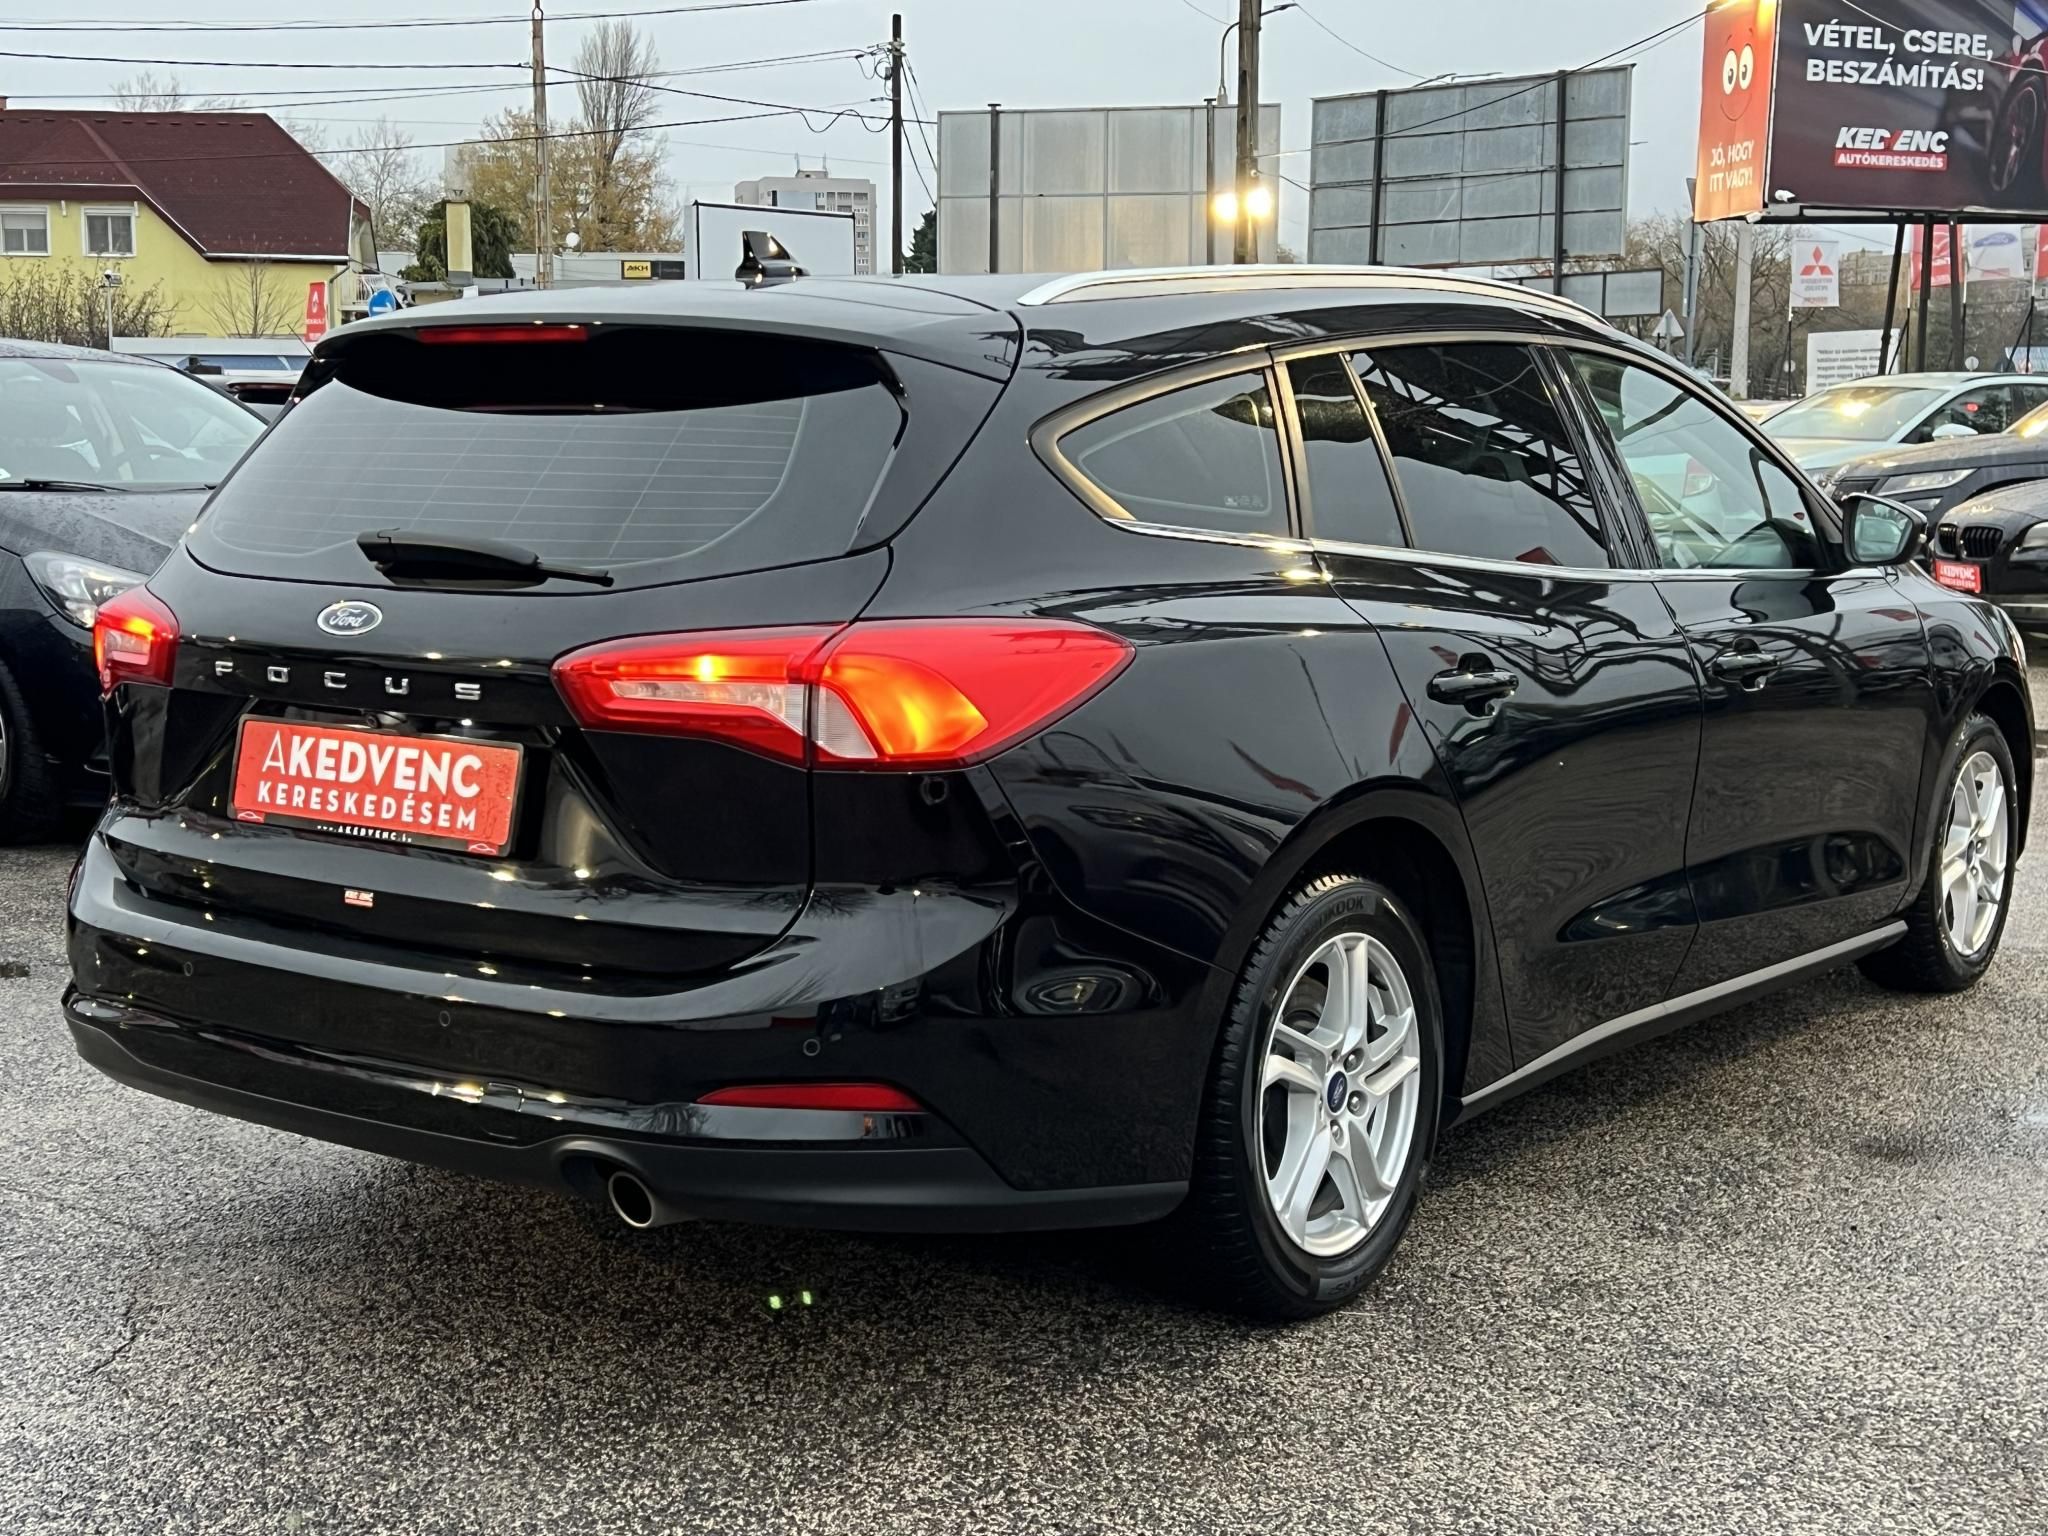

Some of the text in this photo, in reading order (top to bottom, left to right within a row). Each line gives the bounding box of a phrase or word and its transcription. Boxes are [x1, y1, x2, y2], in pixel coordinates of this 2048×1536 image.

[1803, 19, 1994, 61] VÉTEL, CSERE,
[1806, 58, 1985, 91] BESZÁMÍTÁS!
[1710, 139, 1755, 168] JÓ, HOGY
[1837, 152, 1944, 169] AUTÓKERESKEDÉS
[1709, 166, 1753, 192] ITT VAGY!
[329, 607, 364, 628] Ford
[215, 660, 481, 700] FOCUS
[258, 780, 477, 831] KERESKEDÉSEM
